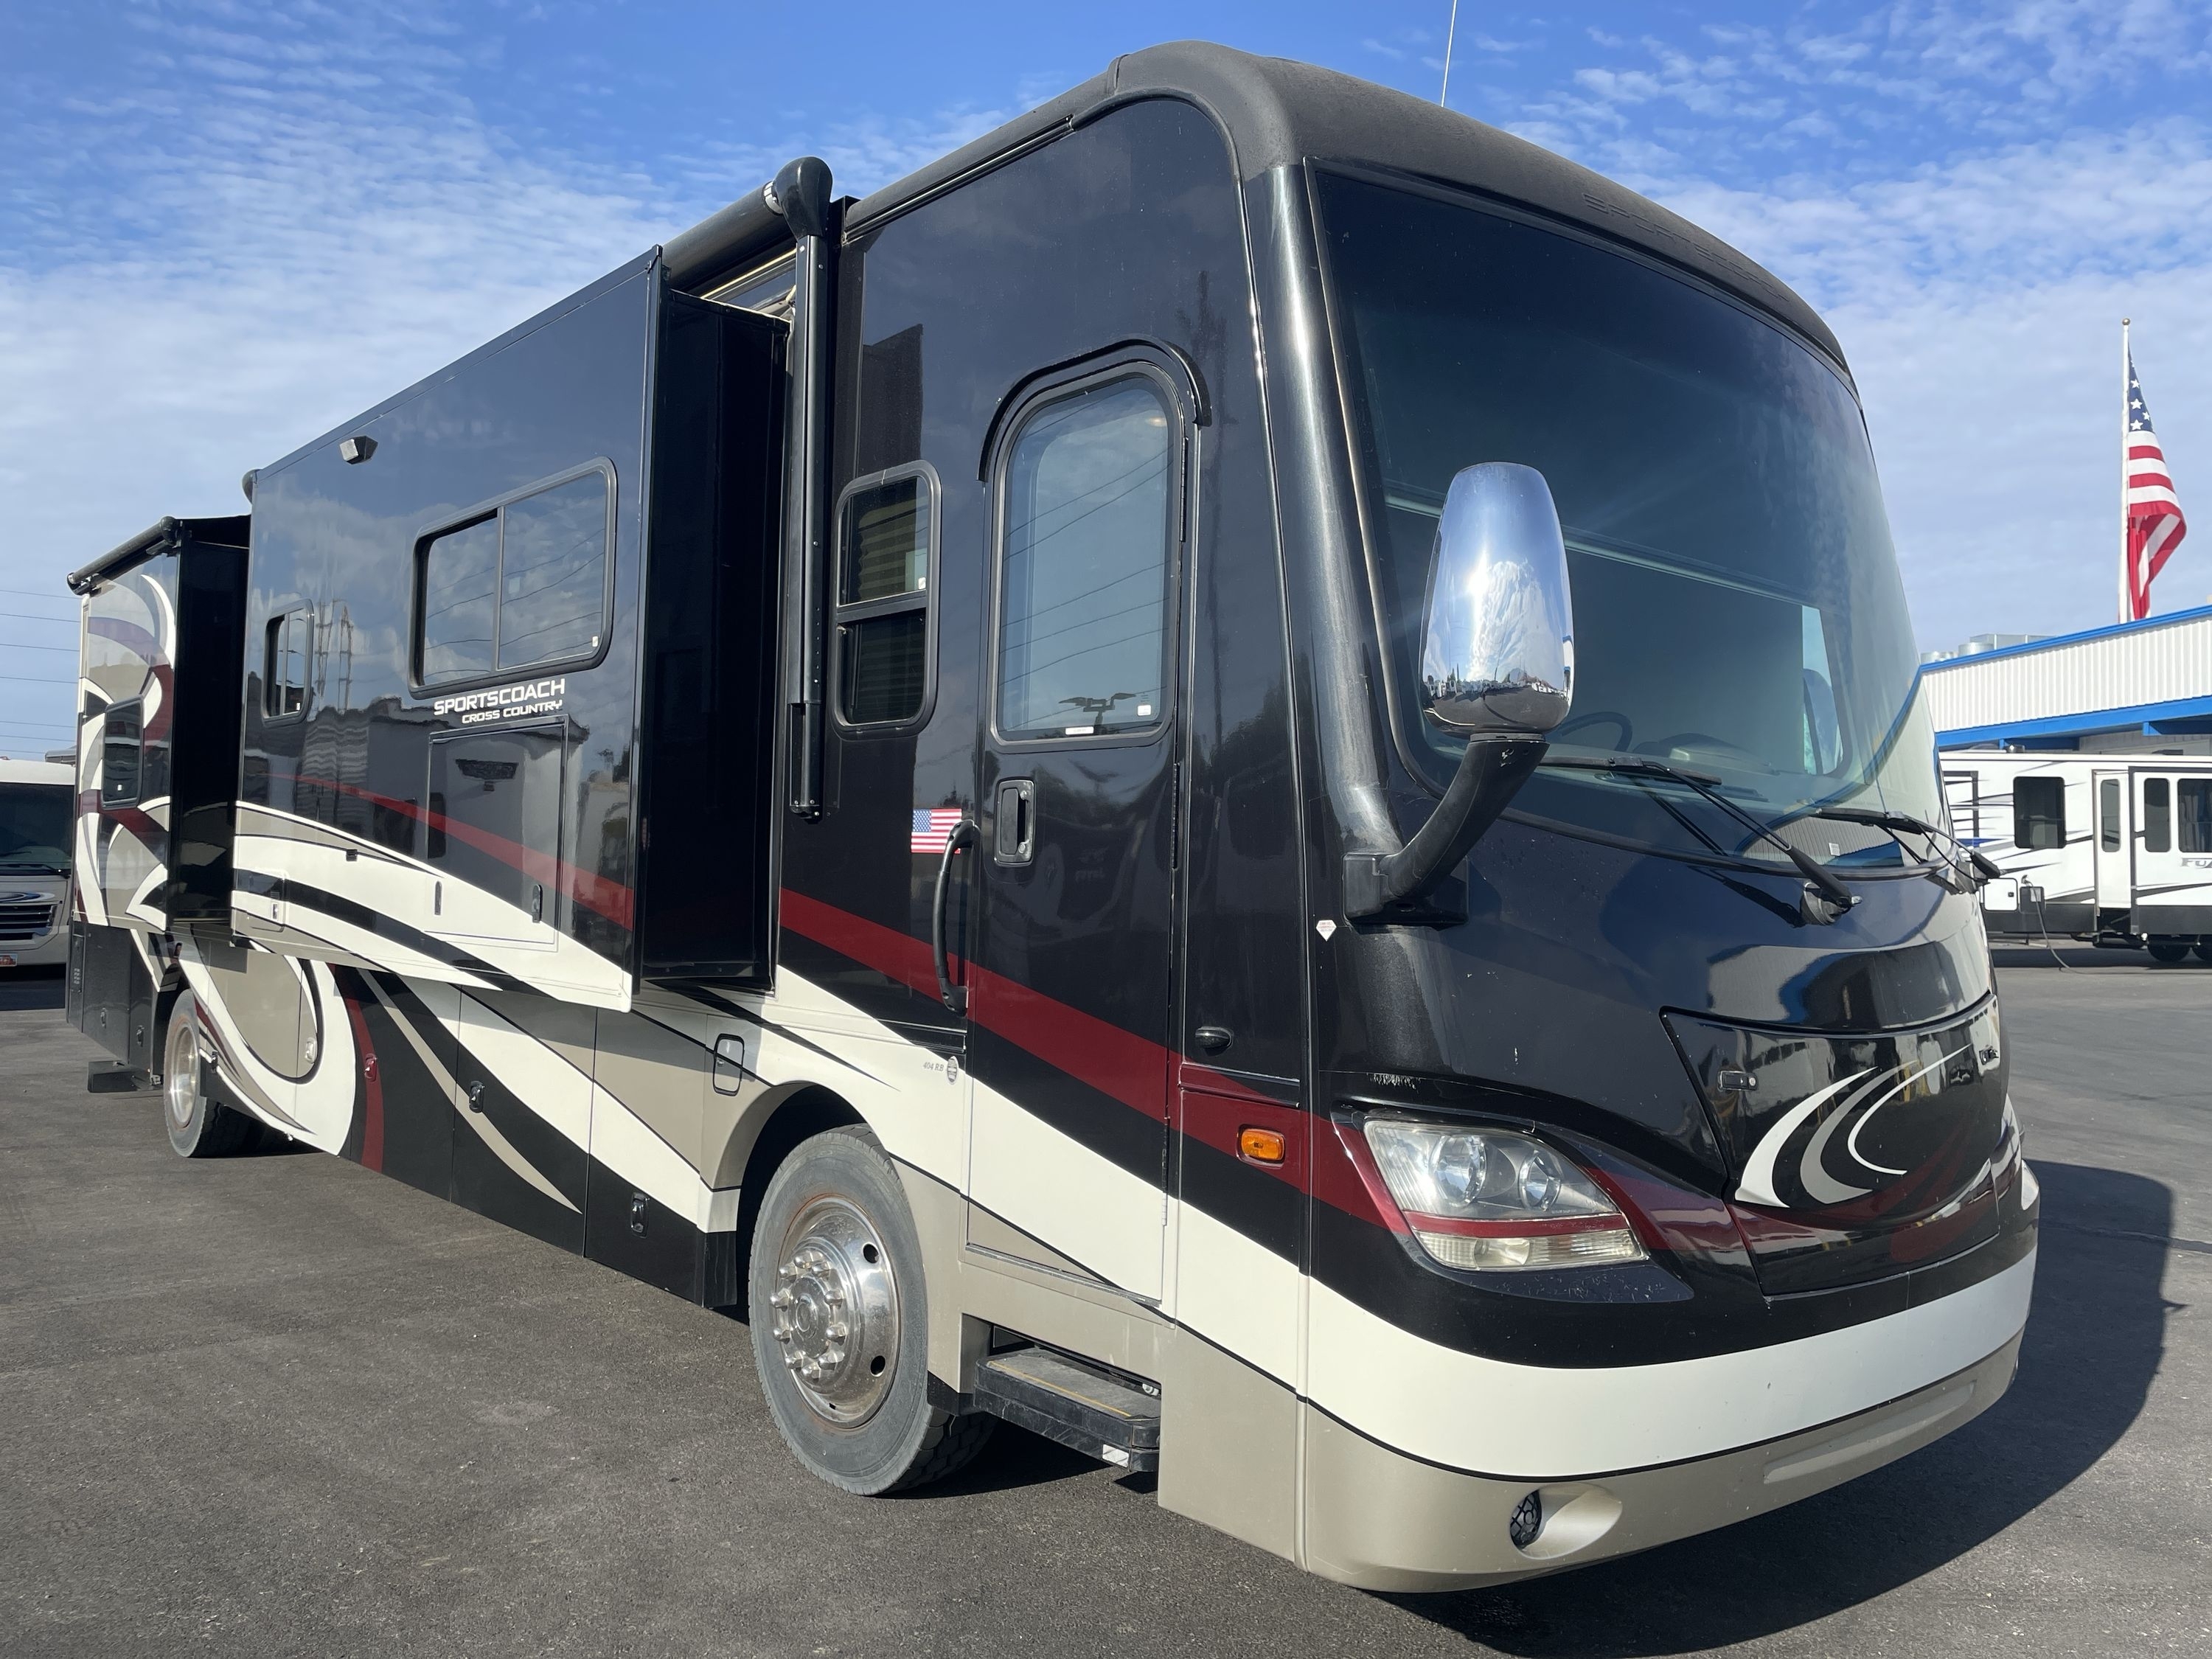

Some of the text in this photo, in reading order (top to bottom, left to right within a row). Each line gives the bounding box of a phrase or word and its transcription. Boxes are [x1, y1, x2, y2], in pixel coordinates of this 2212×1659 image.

[434, 678, 566, 715] SPORTSCOACH
[462, 699, 563, 724] CROSS COUNTRY
